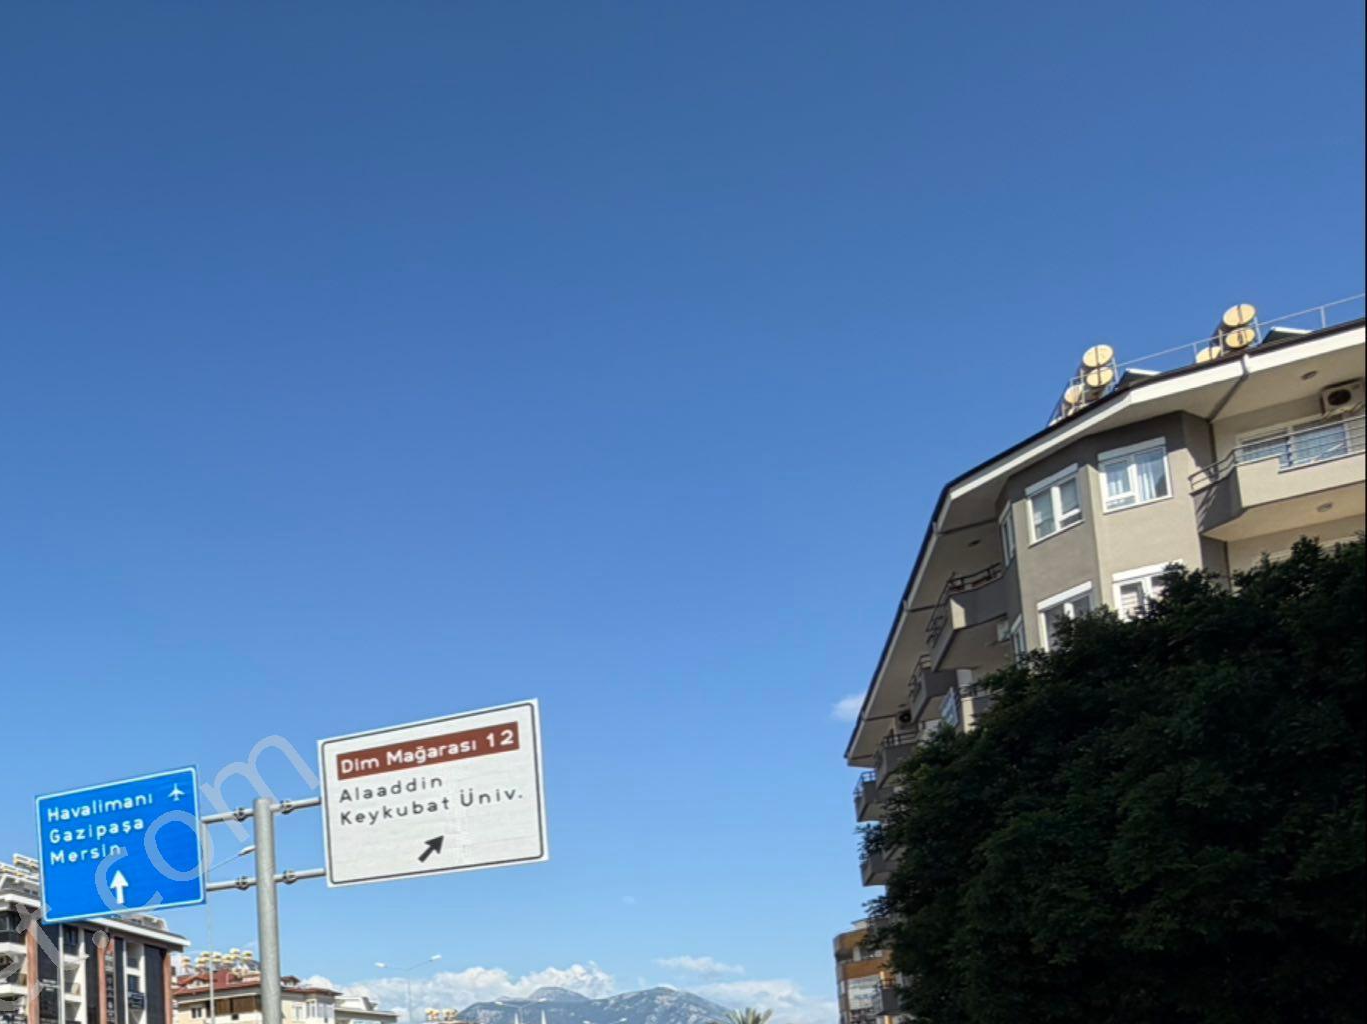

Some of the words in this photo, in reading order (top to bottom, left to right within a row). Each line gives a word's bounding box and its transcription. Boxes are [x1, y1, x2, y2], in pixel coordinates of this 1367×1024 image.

[340, 757, 380, 774] Dim
[386, 740, 477, 765] Mağarası
[486, 729, 514, 748] 12
[339, 776, 443, 803] Alaaddin
[47, 793, 153, 822] Havalimanı
[340, 797, 450, 825] Keykubat
[460, 788, 523, 807] Üniv.
[49, 818, 144, 844] Gazipaşa
[50, 843, 122, 865] Mersin
